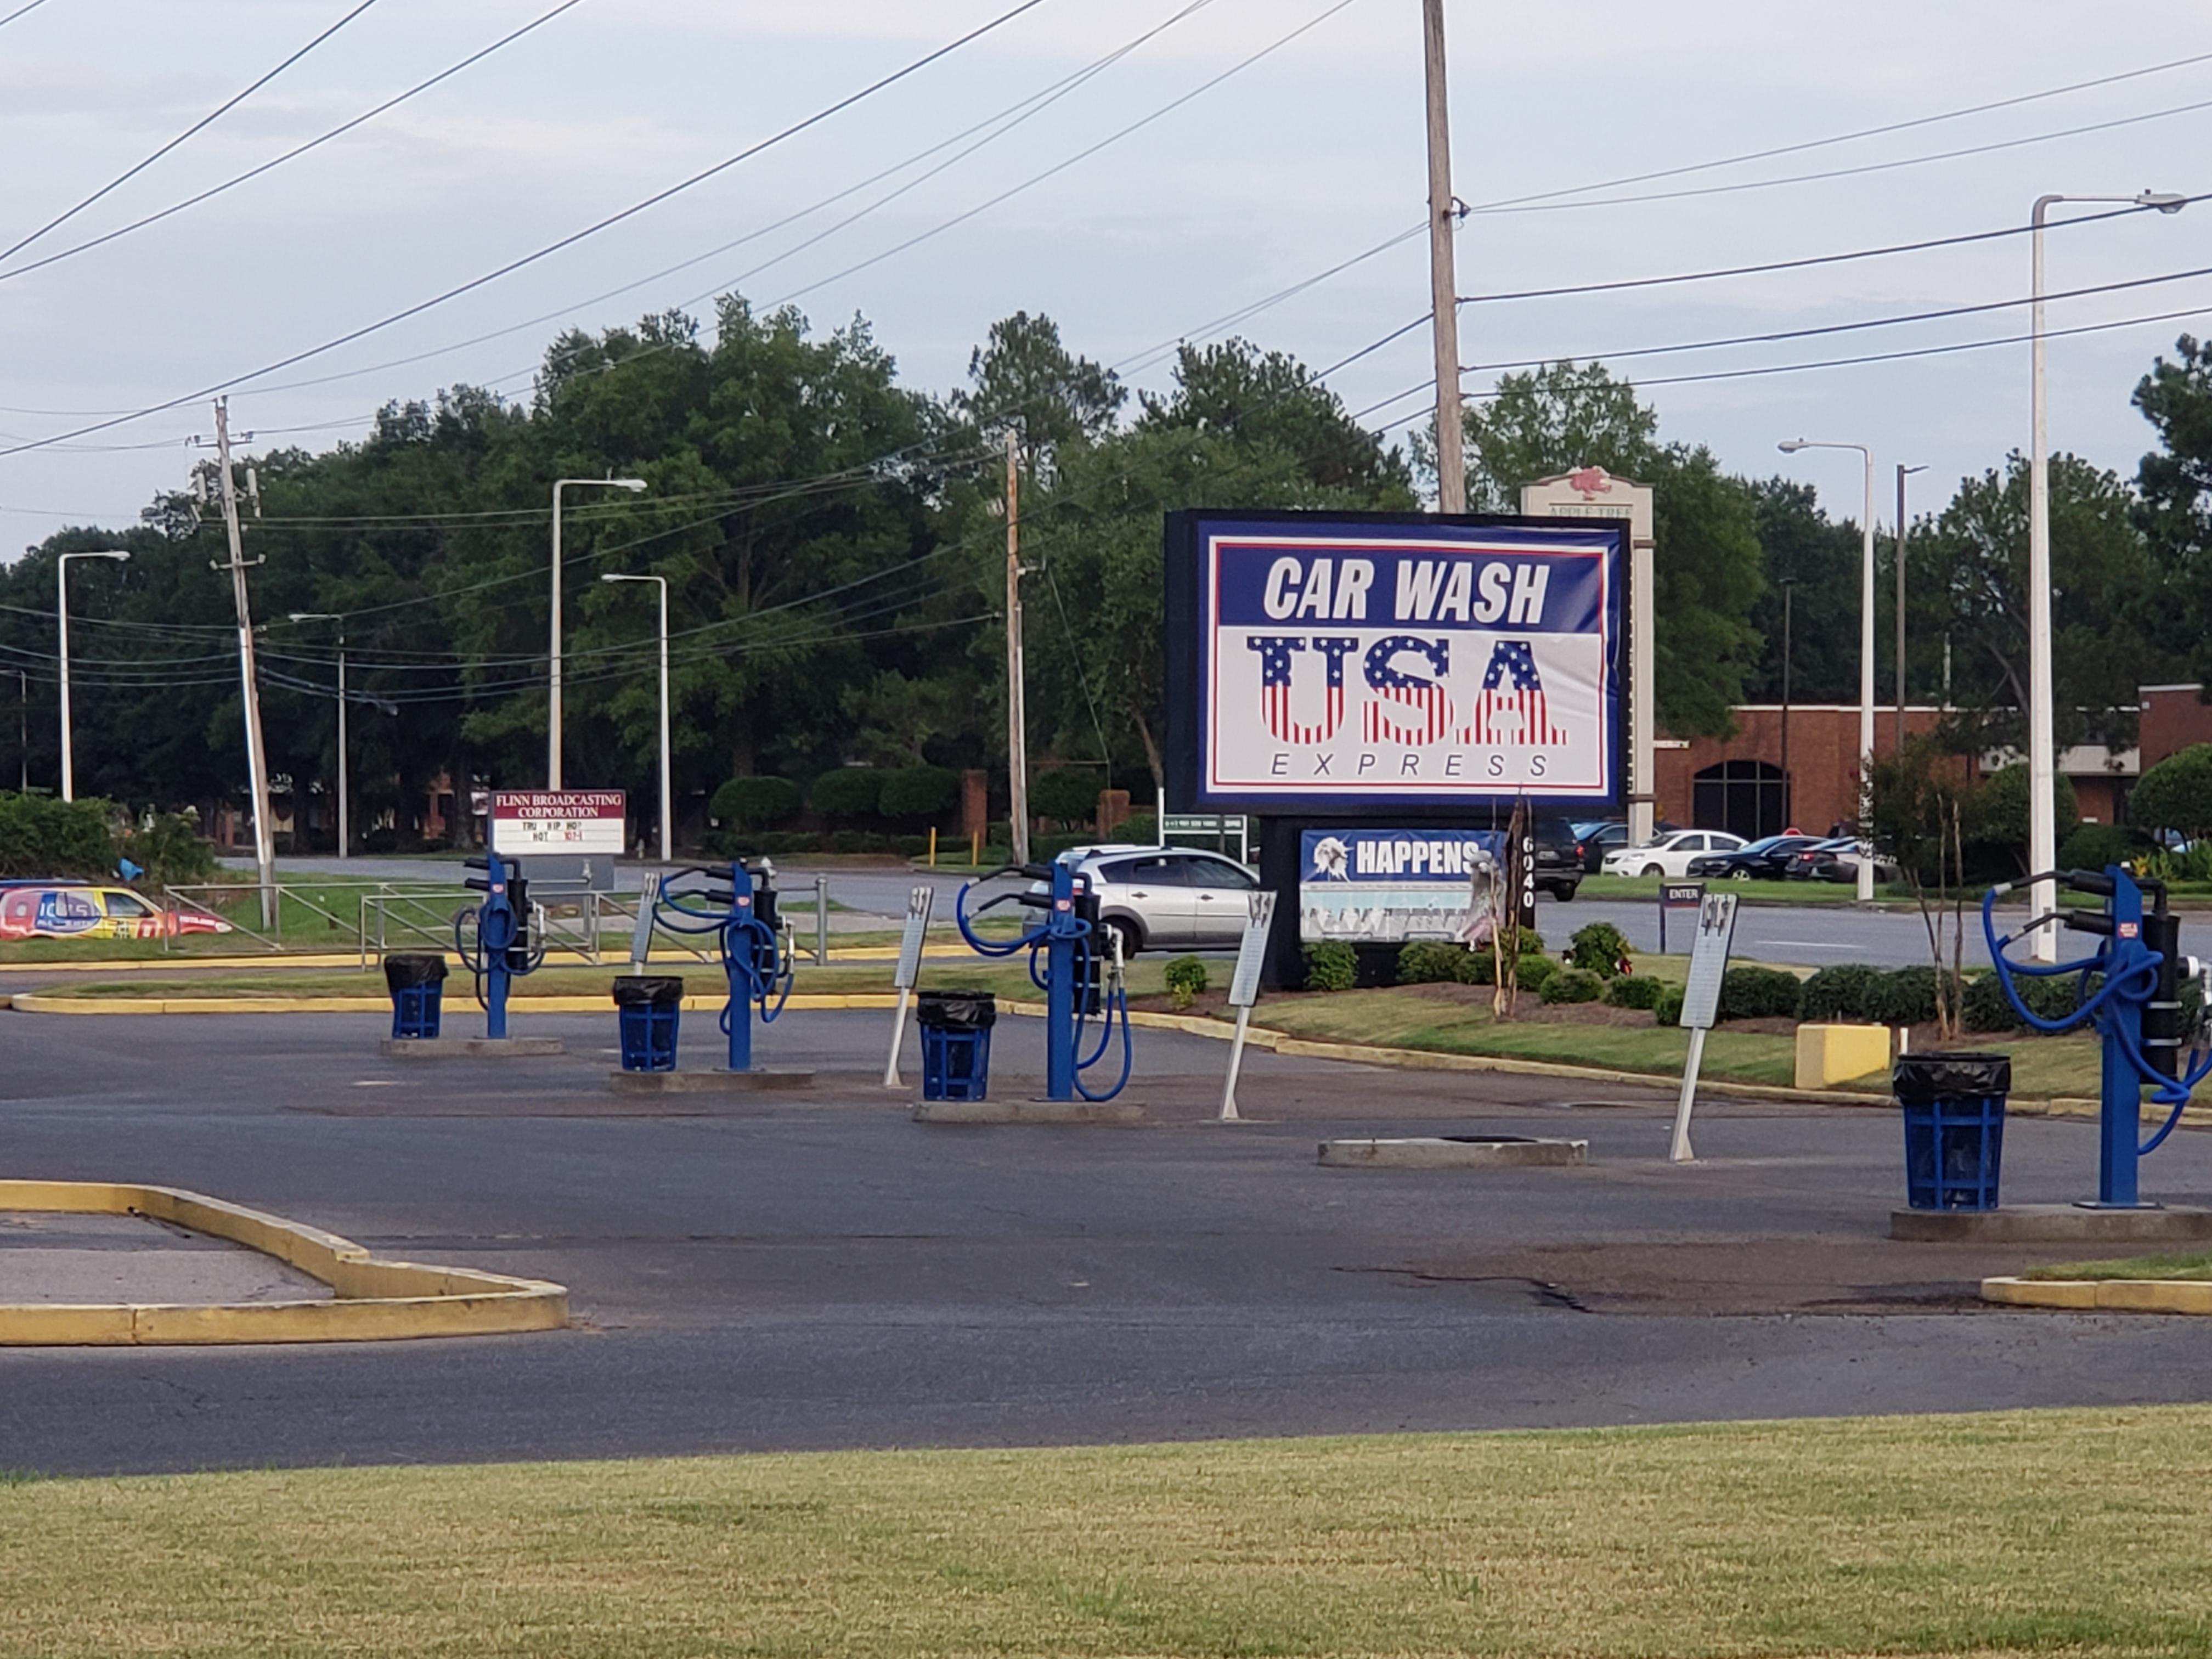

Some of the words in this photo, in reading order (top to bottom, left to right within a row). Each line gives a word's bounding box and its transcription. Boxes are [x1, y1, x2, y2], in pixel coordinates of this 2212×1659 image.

[1263, 557, 1375, 620] CAR
[1395, 560, 1550, 624] WASH
[1247, 635, 1569, 746] USA
[1271, 753, 1548, 776] EXPRESS
[496, 794, 529, 806] FLINN
[533, 794, 621, 805] BROADCASTING
[518, 806, 599, 817] CORPORATION
[1356, 841, 1480, 874] HAPPENS
[1522, 837, 1534, 908] 6040
[1669, 889, 1699, 899] ENTER
